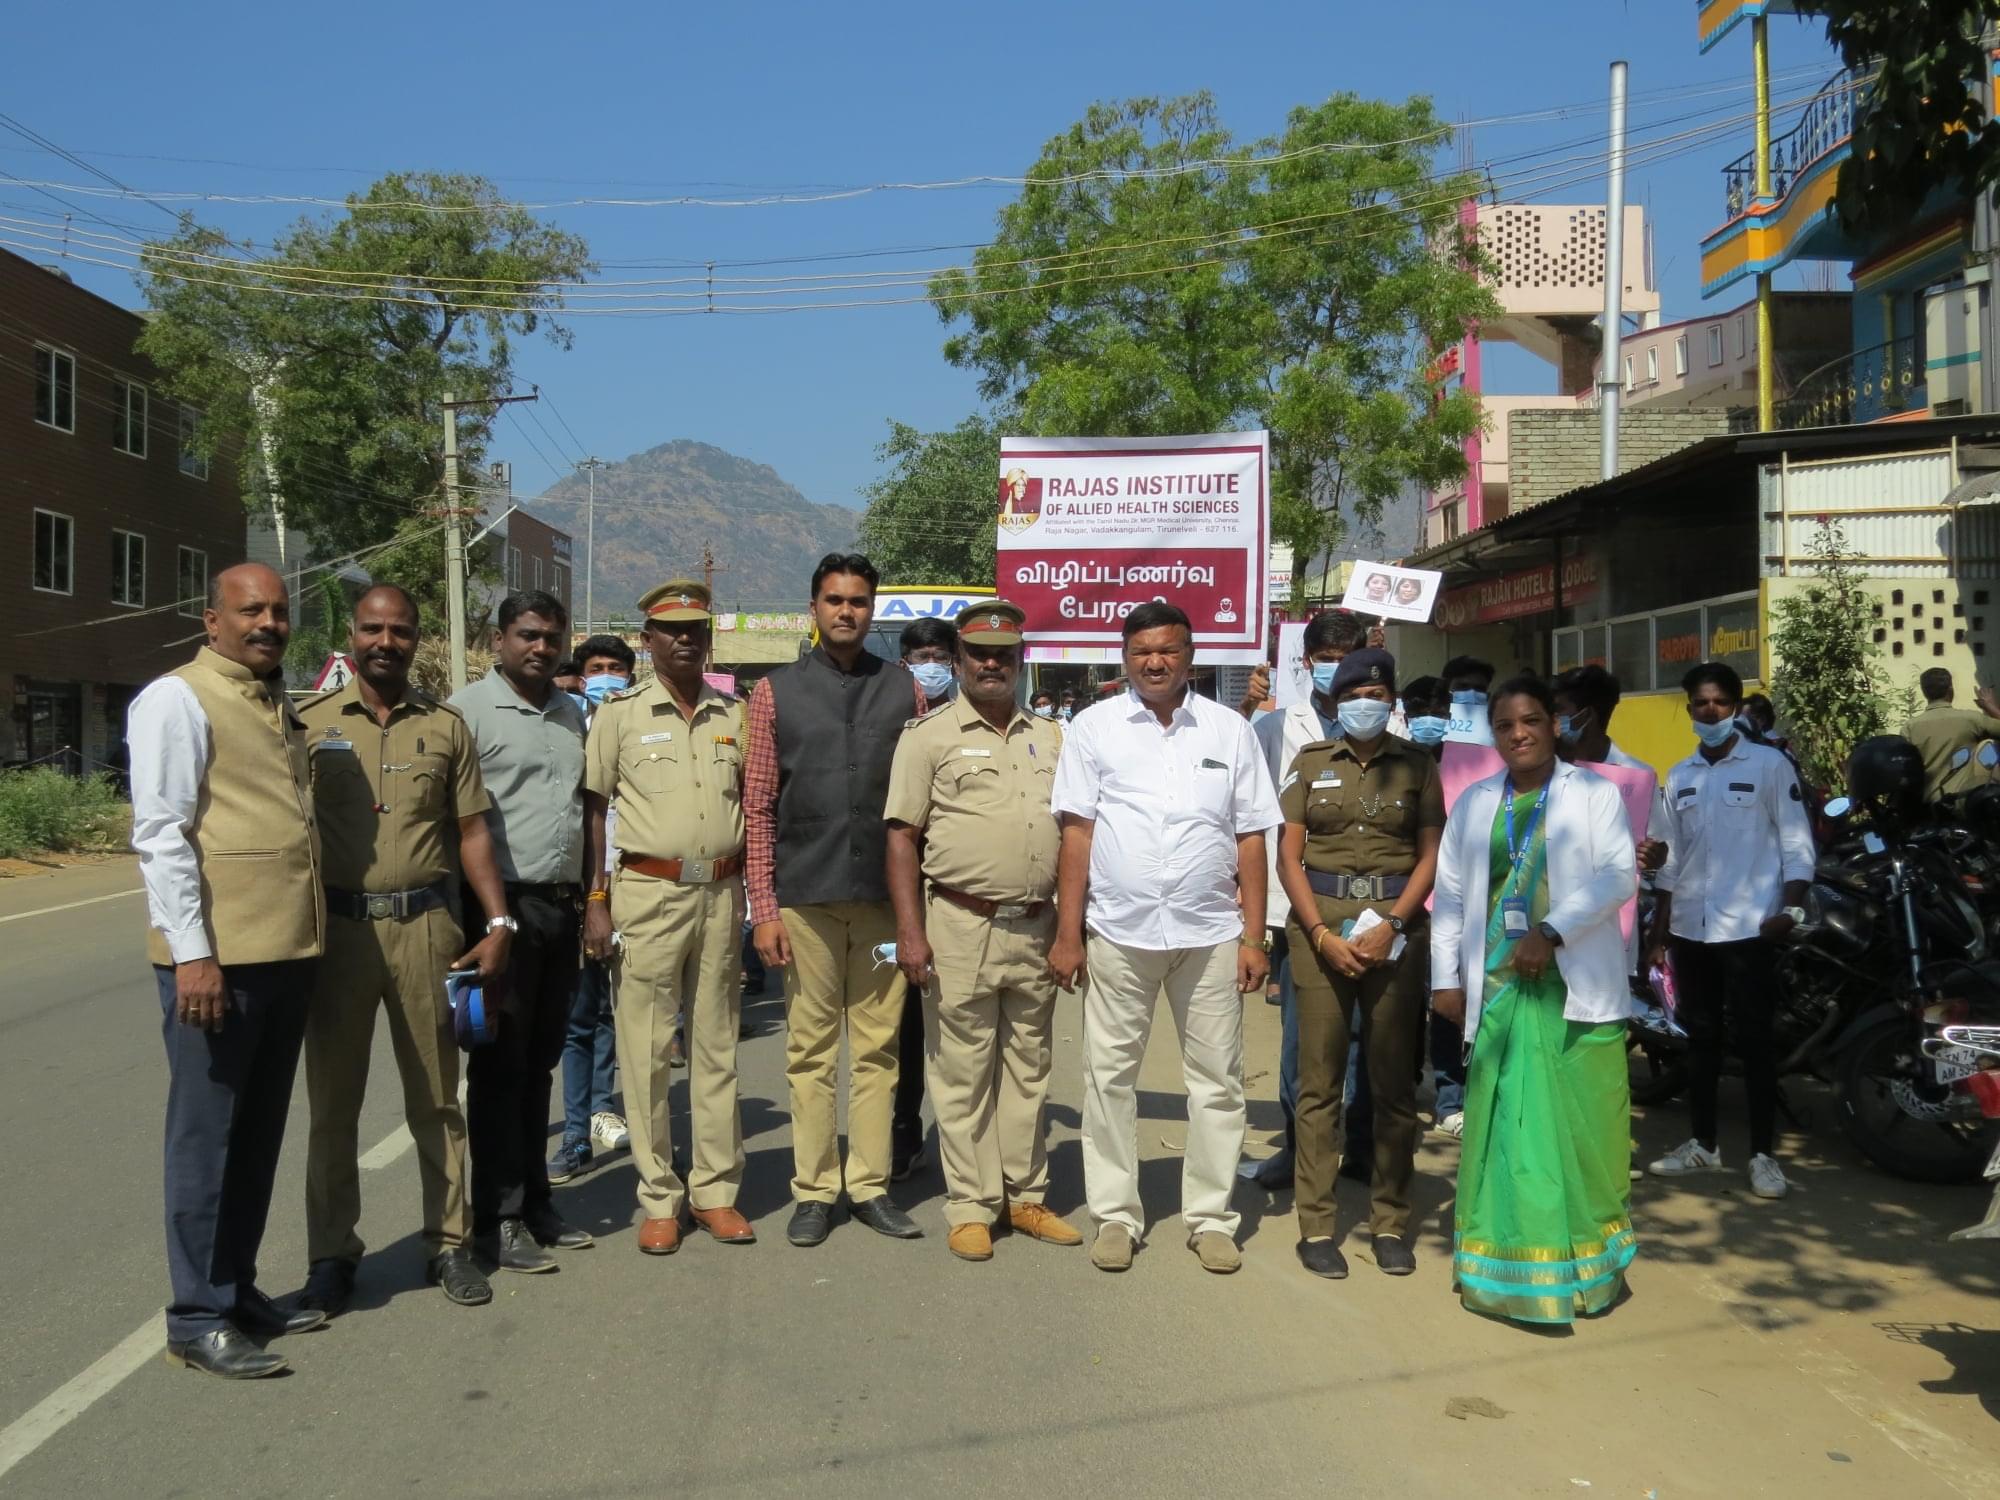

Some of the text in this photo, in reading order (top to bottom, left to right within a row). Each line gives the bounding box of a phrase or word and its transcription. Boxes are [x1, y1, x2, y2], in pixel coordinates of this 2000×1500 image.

[1048, 473, 1240, 497] RAJAS INSTITUTE
[1046, 500, 1240, 516] OF ALLIED HEALTH SCIENCES
[1001, 516, 1031, 526] RAJAS
[1045, 527, 1062, 536] Raja
[1064, 527, 1089, 536] Nagar,
[1090, 526, 1154, 535] Vadakkangulam,
[1157, 525, 1198, 533] Tirunelveli
[1205, 525, 1220, 533] 627
[1015, 559, 1215, 591] விழிப்புணர்வு
[1514, 572, 1545, 599] HOTEL
[1450, 718, 1473, 732] 022
